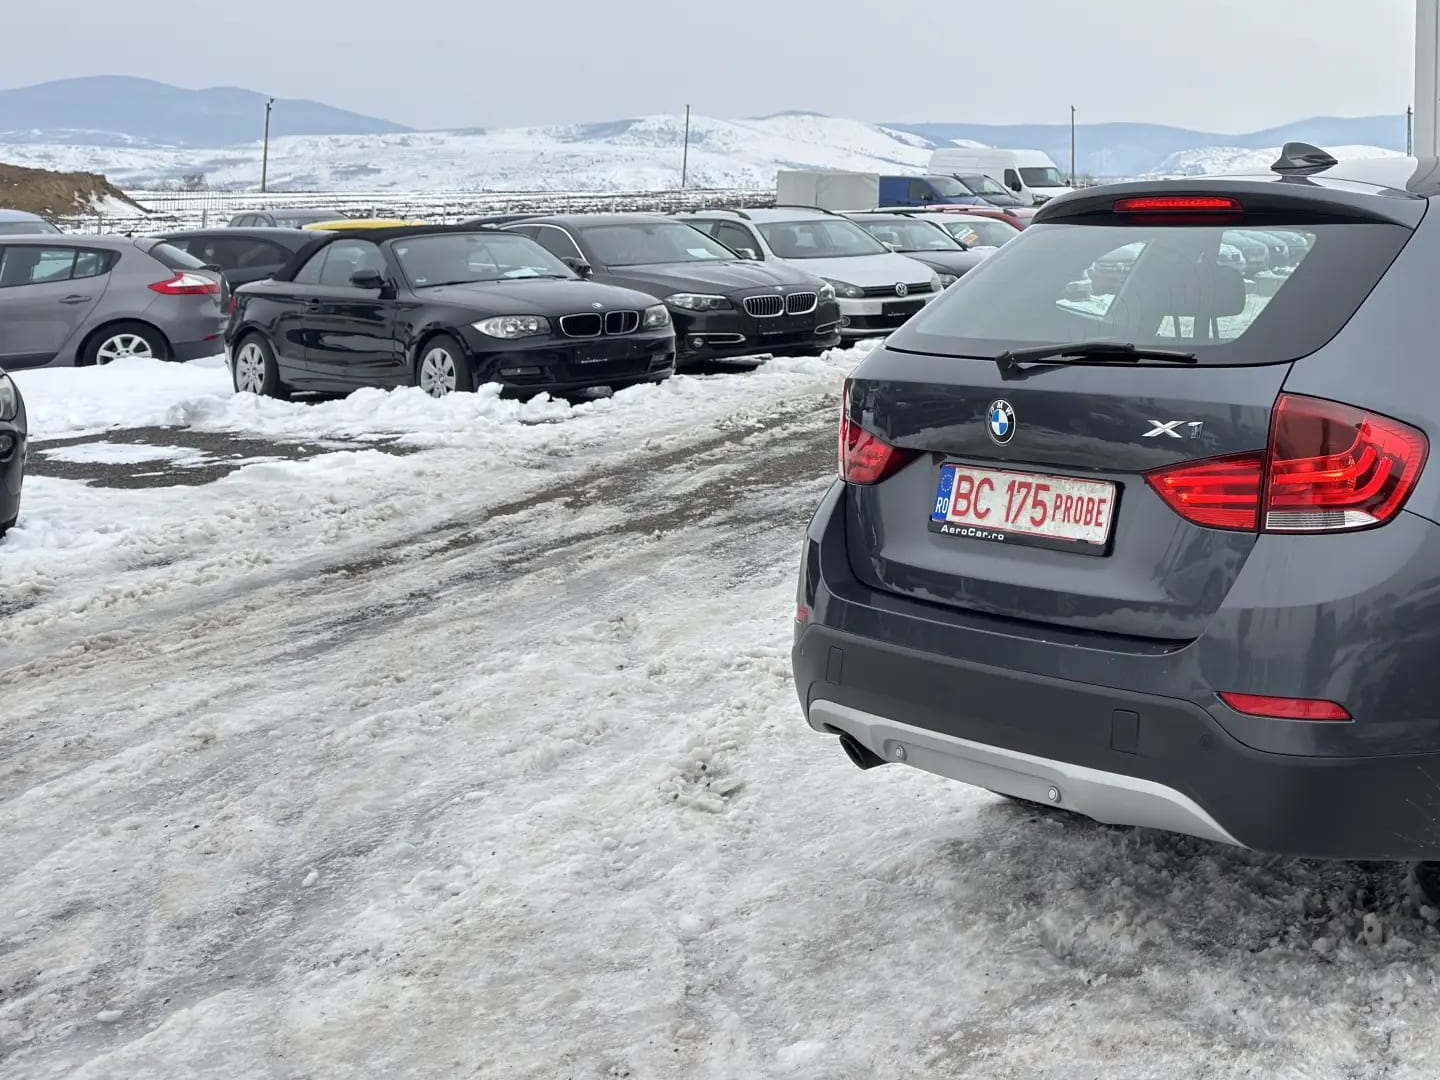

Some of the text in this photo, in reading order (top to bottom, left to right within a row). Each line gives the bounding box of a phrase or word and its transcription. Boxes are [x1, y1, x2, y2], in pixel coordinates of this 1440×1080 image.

[1141, 419, 1204, 439] X1
[935, 497, 950, 514] RO
[951, 475, 1107, 527] BC 175 PROBE
[941, 524, 1005, 541] AeroCar.ro
